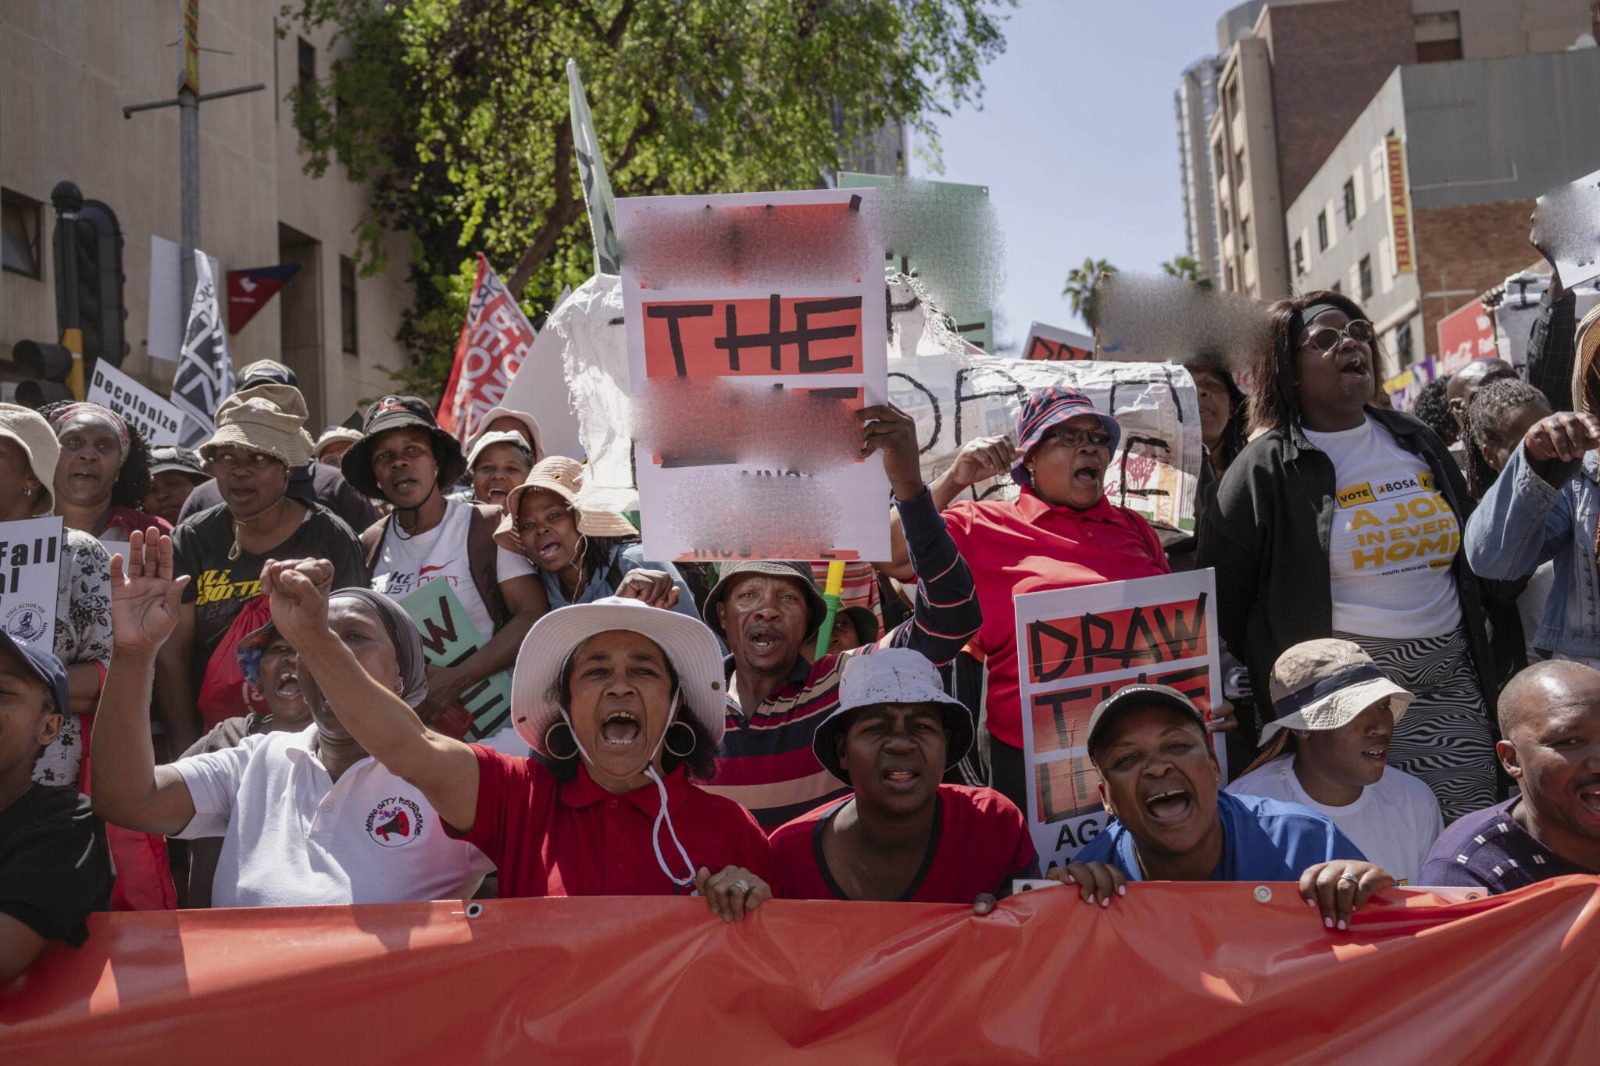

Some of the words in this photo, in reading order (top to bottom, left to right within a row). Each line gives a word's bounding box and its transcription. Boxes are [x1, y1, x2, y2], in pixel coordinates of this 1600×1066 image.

[1386, 139, 1405, 208] LUXURY
[1393, 213, 1411, 267] HOTEL
[646, 293, 863, 377] THE
[93, 369, 178, 434] Decolonize
[1340, 488, 1369, 503] VOTE
[1385, 479, 1418, 493] BOSA
[1349, 507, 1384, 531] A
[1357, 530, 1385, 546] IN
[1030, 591, 1208, 683] DRAW
